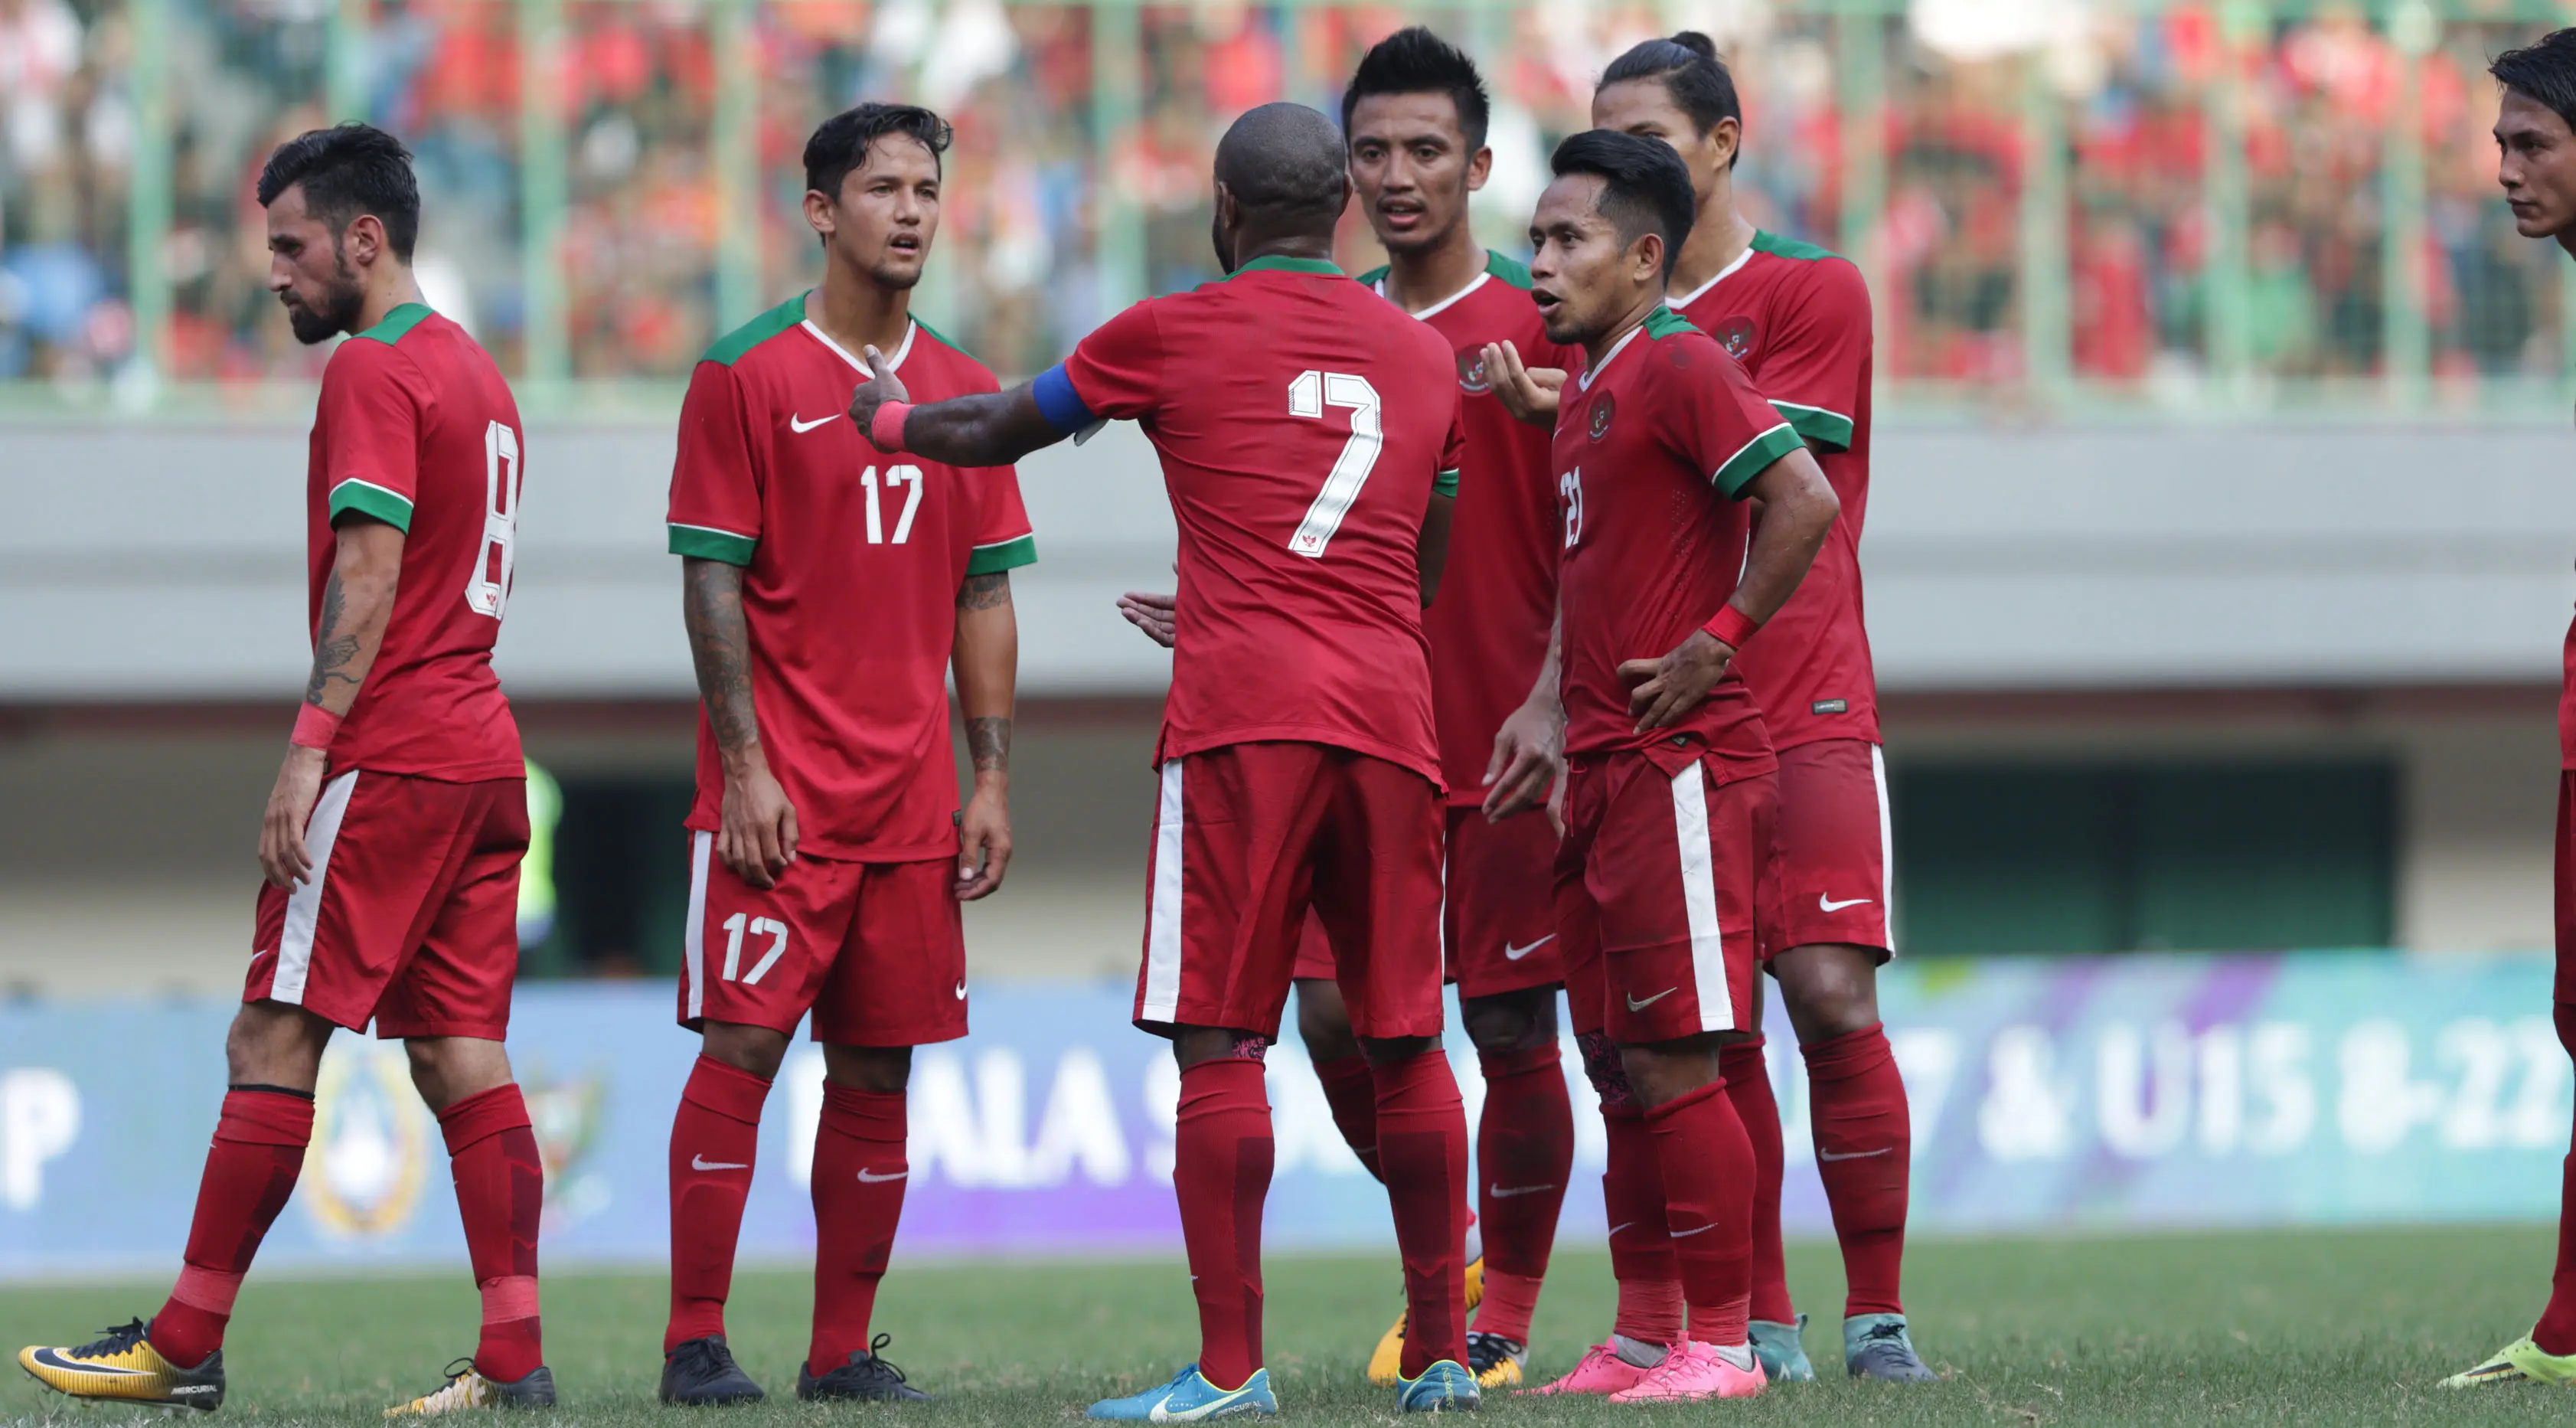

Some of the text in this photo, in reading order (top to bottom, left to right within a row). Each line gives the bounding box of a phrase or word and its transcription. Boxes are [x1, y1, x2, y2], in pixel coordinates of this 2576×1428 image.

[860, 465, 923, 544] 17
[1288, 370, 1383, 557] 7
[465, 420, 519, 621] 8
[1560, 466, 1583, 549] 21
[723, 913, 788, 985] 17
[2098, 1021, 2315, 1158] U15
[171, 1384, 218, 1395] MERCURIAL
